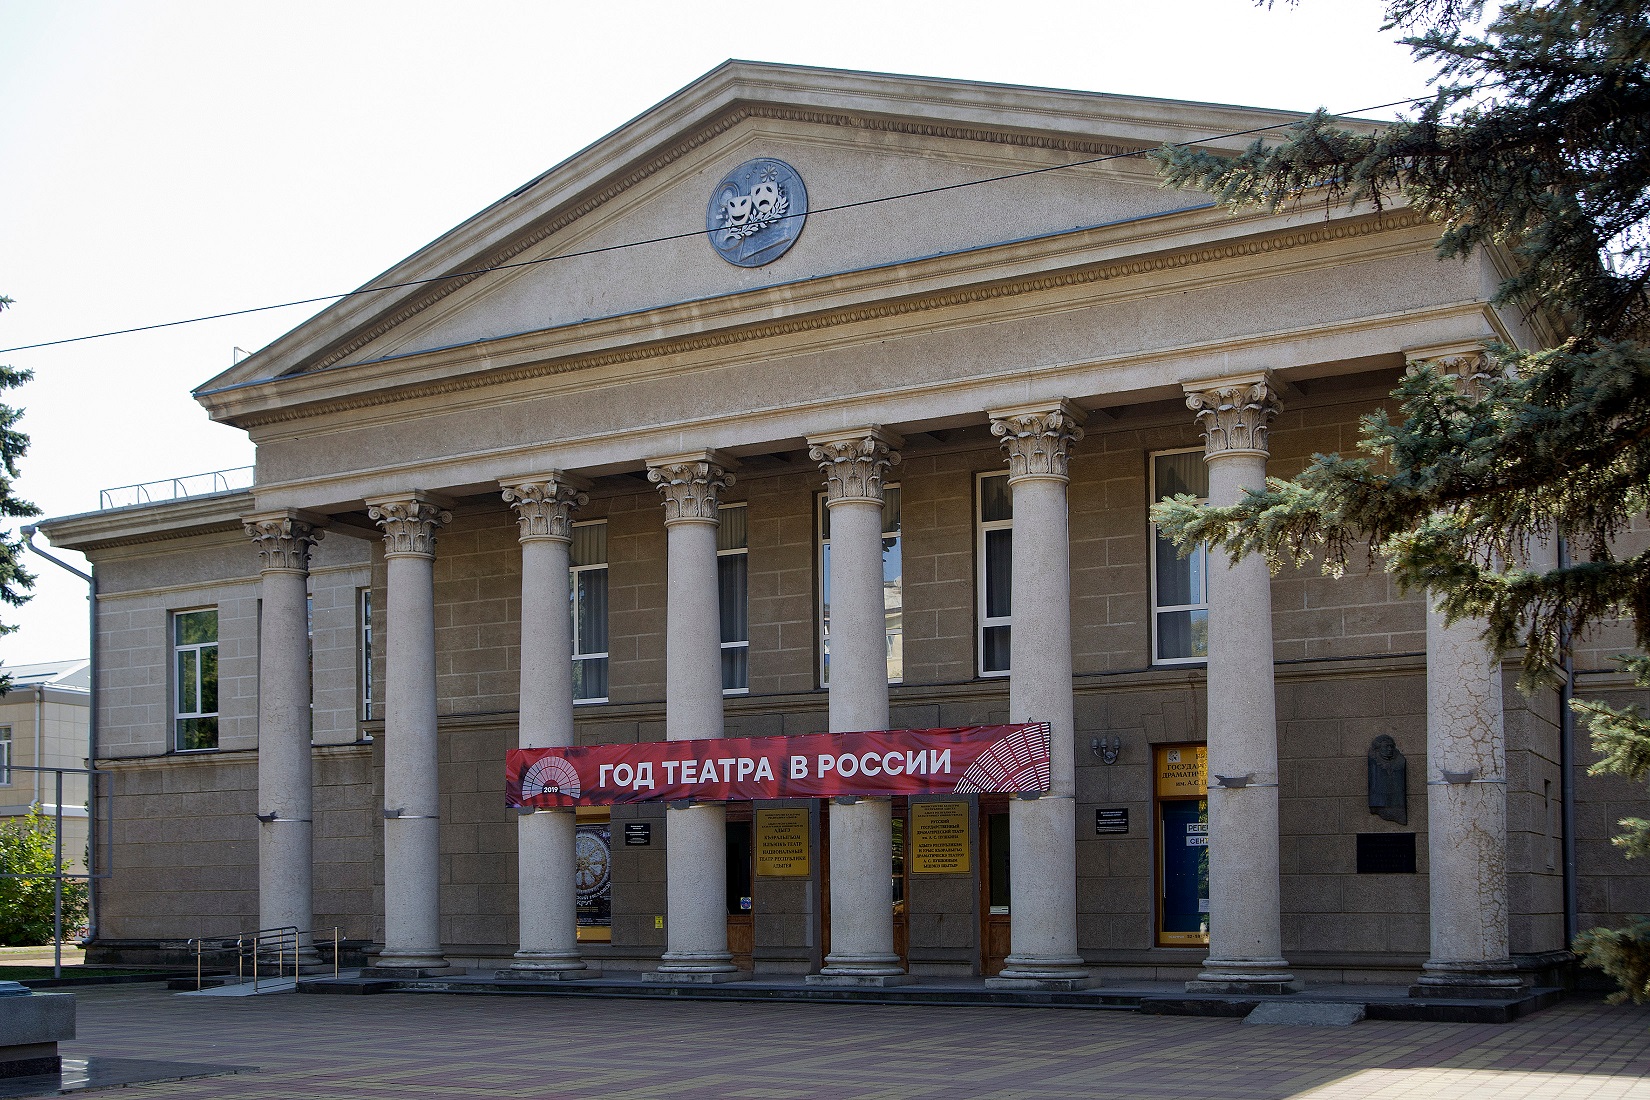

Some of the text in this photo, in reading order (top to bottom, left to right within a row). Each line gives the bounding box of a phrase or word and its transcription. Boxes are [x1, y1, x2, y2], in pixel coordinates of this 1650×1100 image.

[599, 749, 951, 791] ГОД ТЕАТРА В РОССИИ
